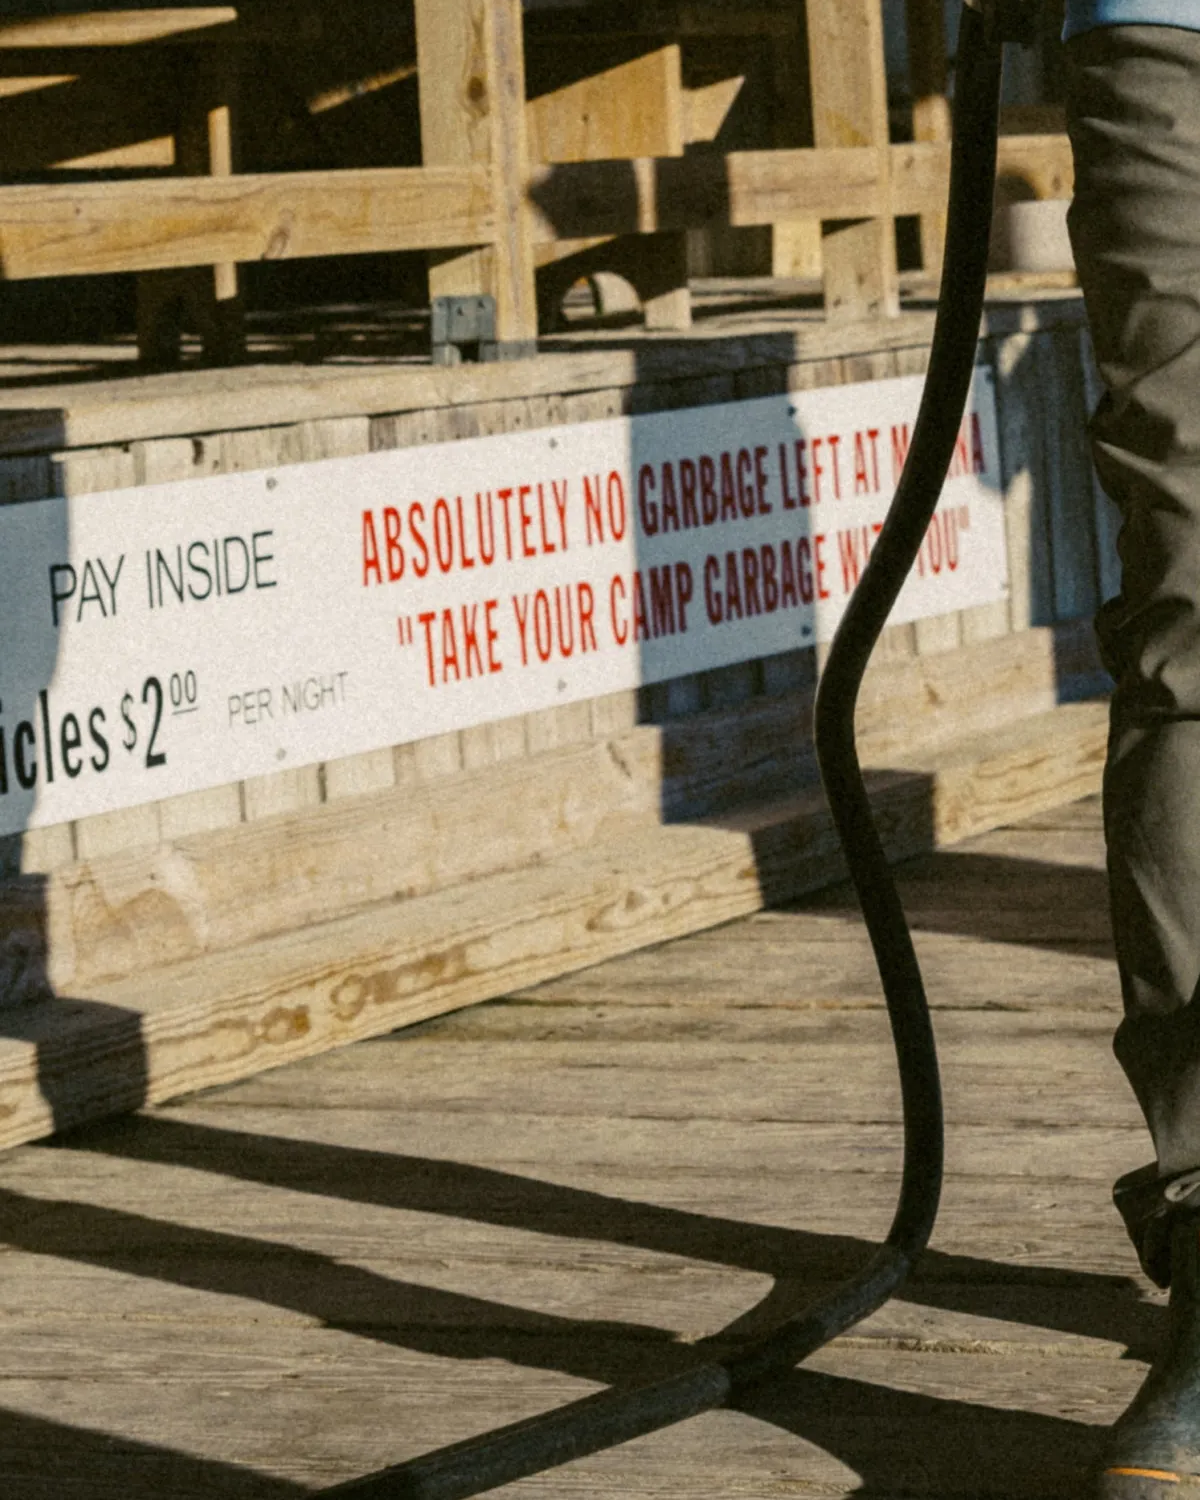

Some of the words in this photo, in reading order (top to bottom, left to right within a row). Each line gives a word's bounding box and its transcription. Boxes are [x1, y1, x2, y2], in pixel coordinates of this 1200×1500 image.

[361, 478, 568, 587] ABSOLUTELY
[583, 470, 626, 546] NO
[638, 445, 772, 538] GARBAGE
[778, 434, 840, 512] LEFT
[855, 428, 880, 494] AT
[49, 554, 125, 627] PAY
[146, 530, 278, 609] INSIDE
[512, 582, 597, 666] YOUR
[610, 561, 694, 646] CAMP
[703, 533, 830, 626] GARBAGE
[227, 688, 274, 728] PER
[282, 671, 349, 715] NIGHT
